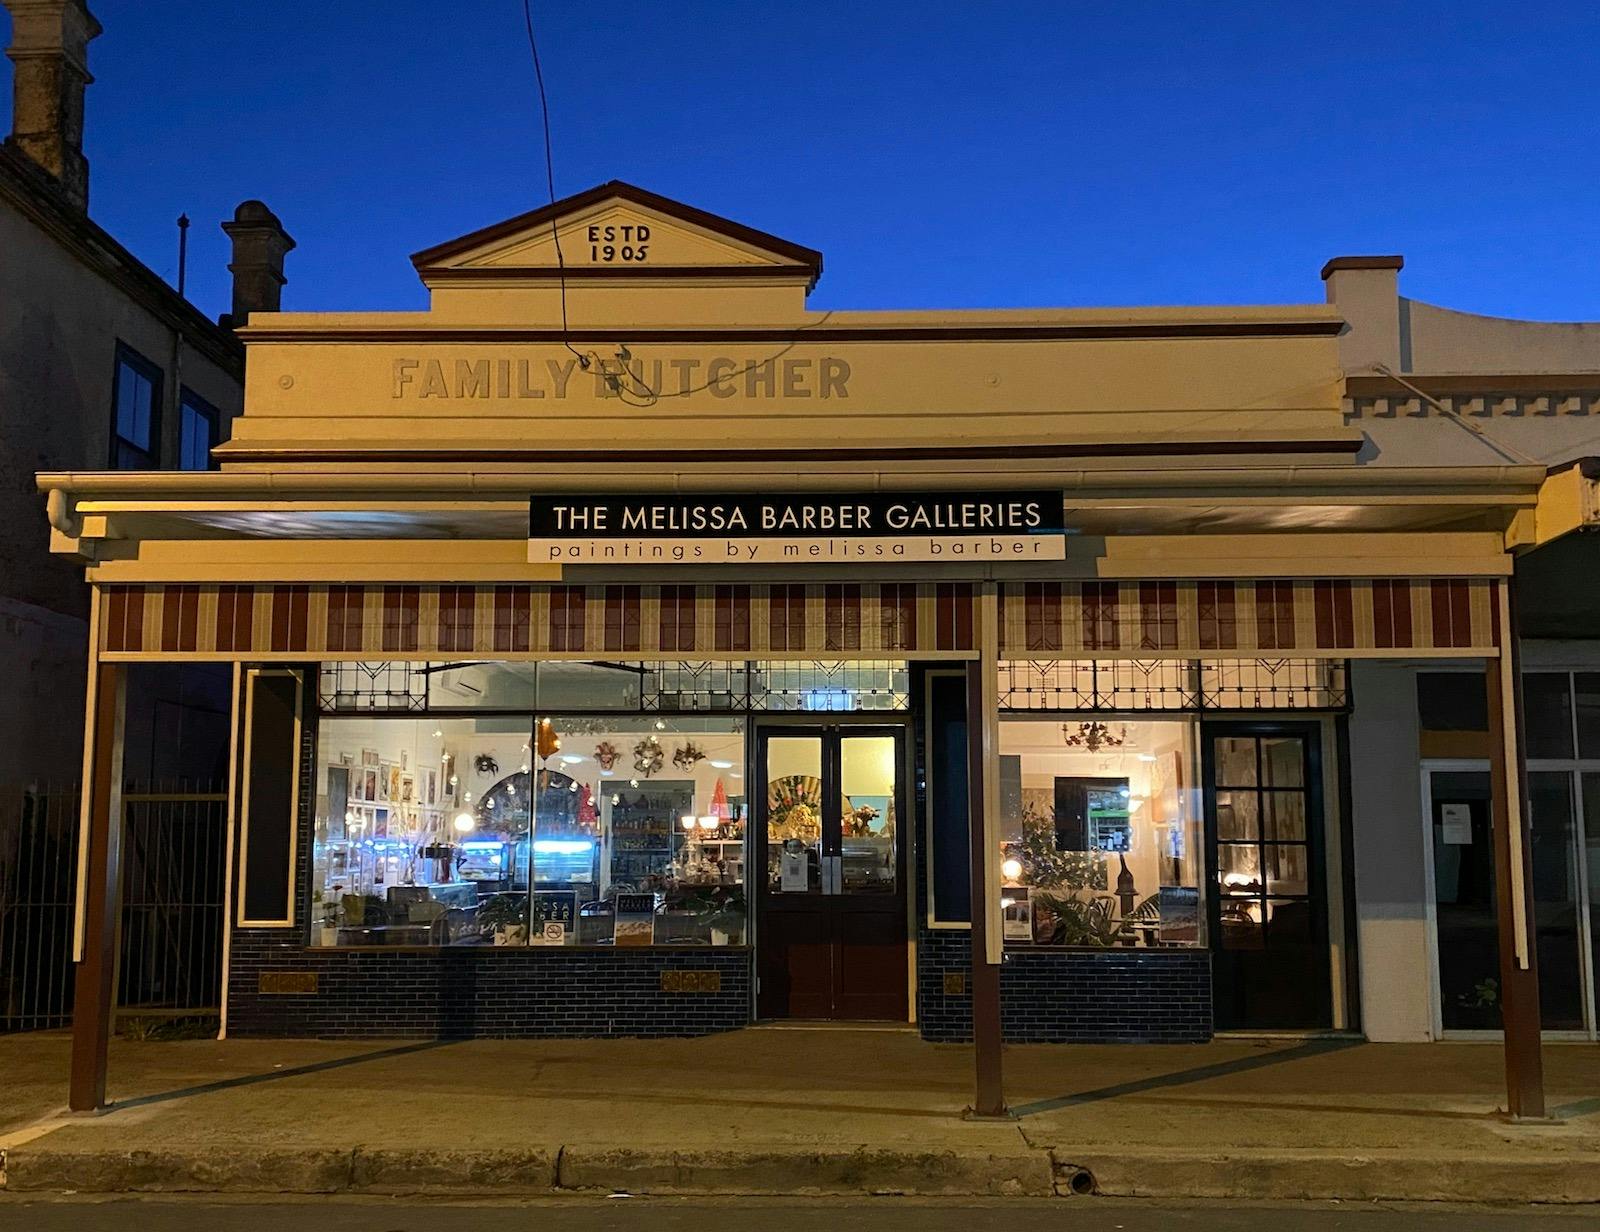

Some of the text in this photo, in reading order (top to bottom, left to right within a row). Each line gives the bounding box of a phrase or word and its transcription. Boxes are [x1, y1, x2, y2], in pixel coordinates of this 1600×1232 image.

[588, 226, 650, 242] ESTD
[591, 245, 649, 262] 1905
[392, 359, 577, 399] FAMILY
[553, 502, 1041, 530] THE MELISSA BARBER GALLERIES
[550, 538, 1041, 560] paintings by melissa barber
